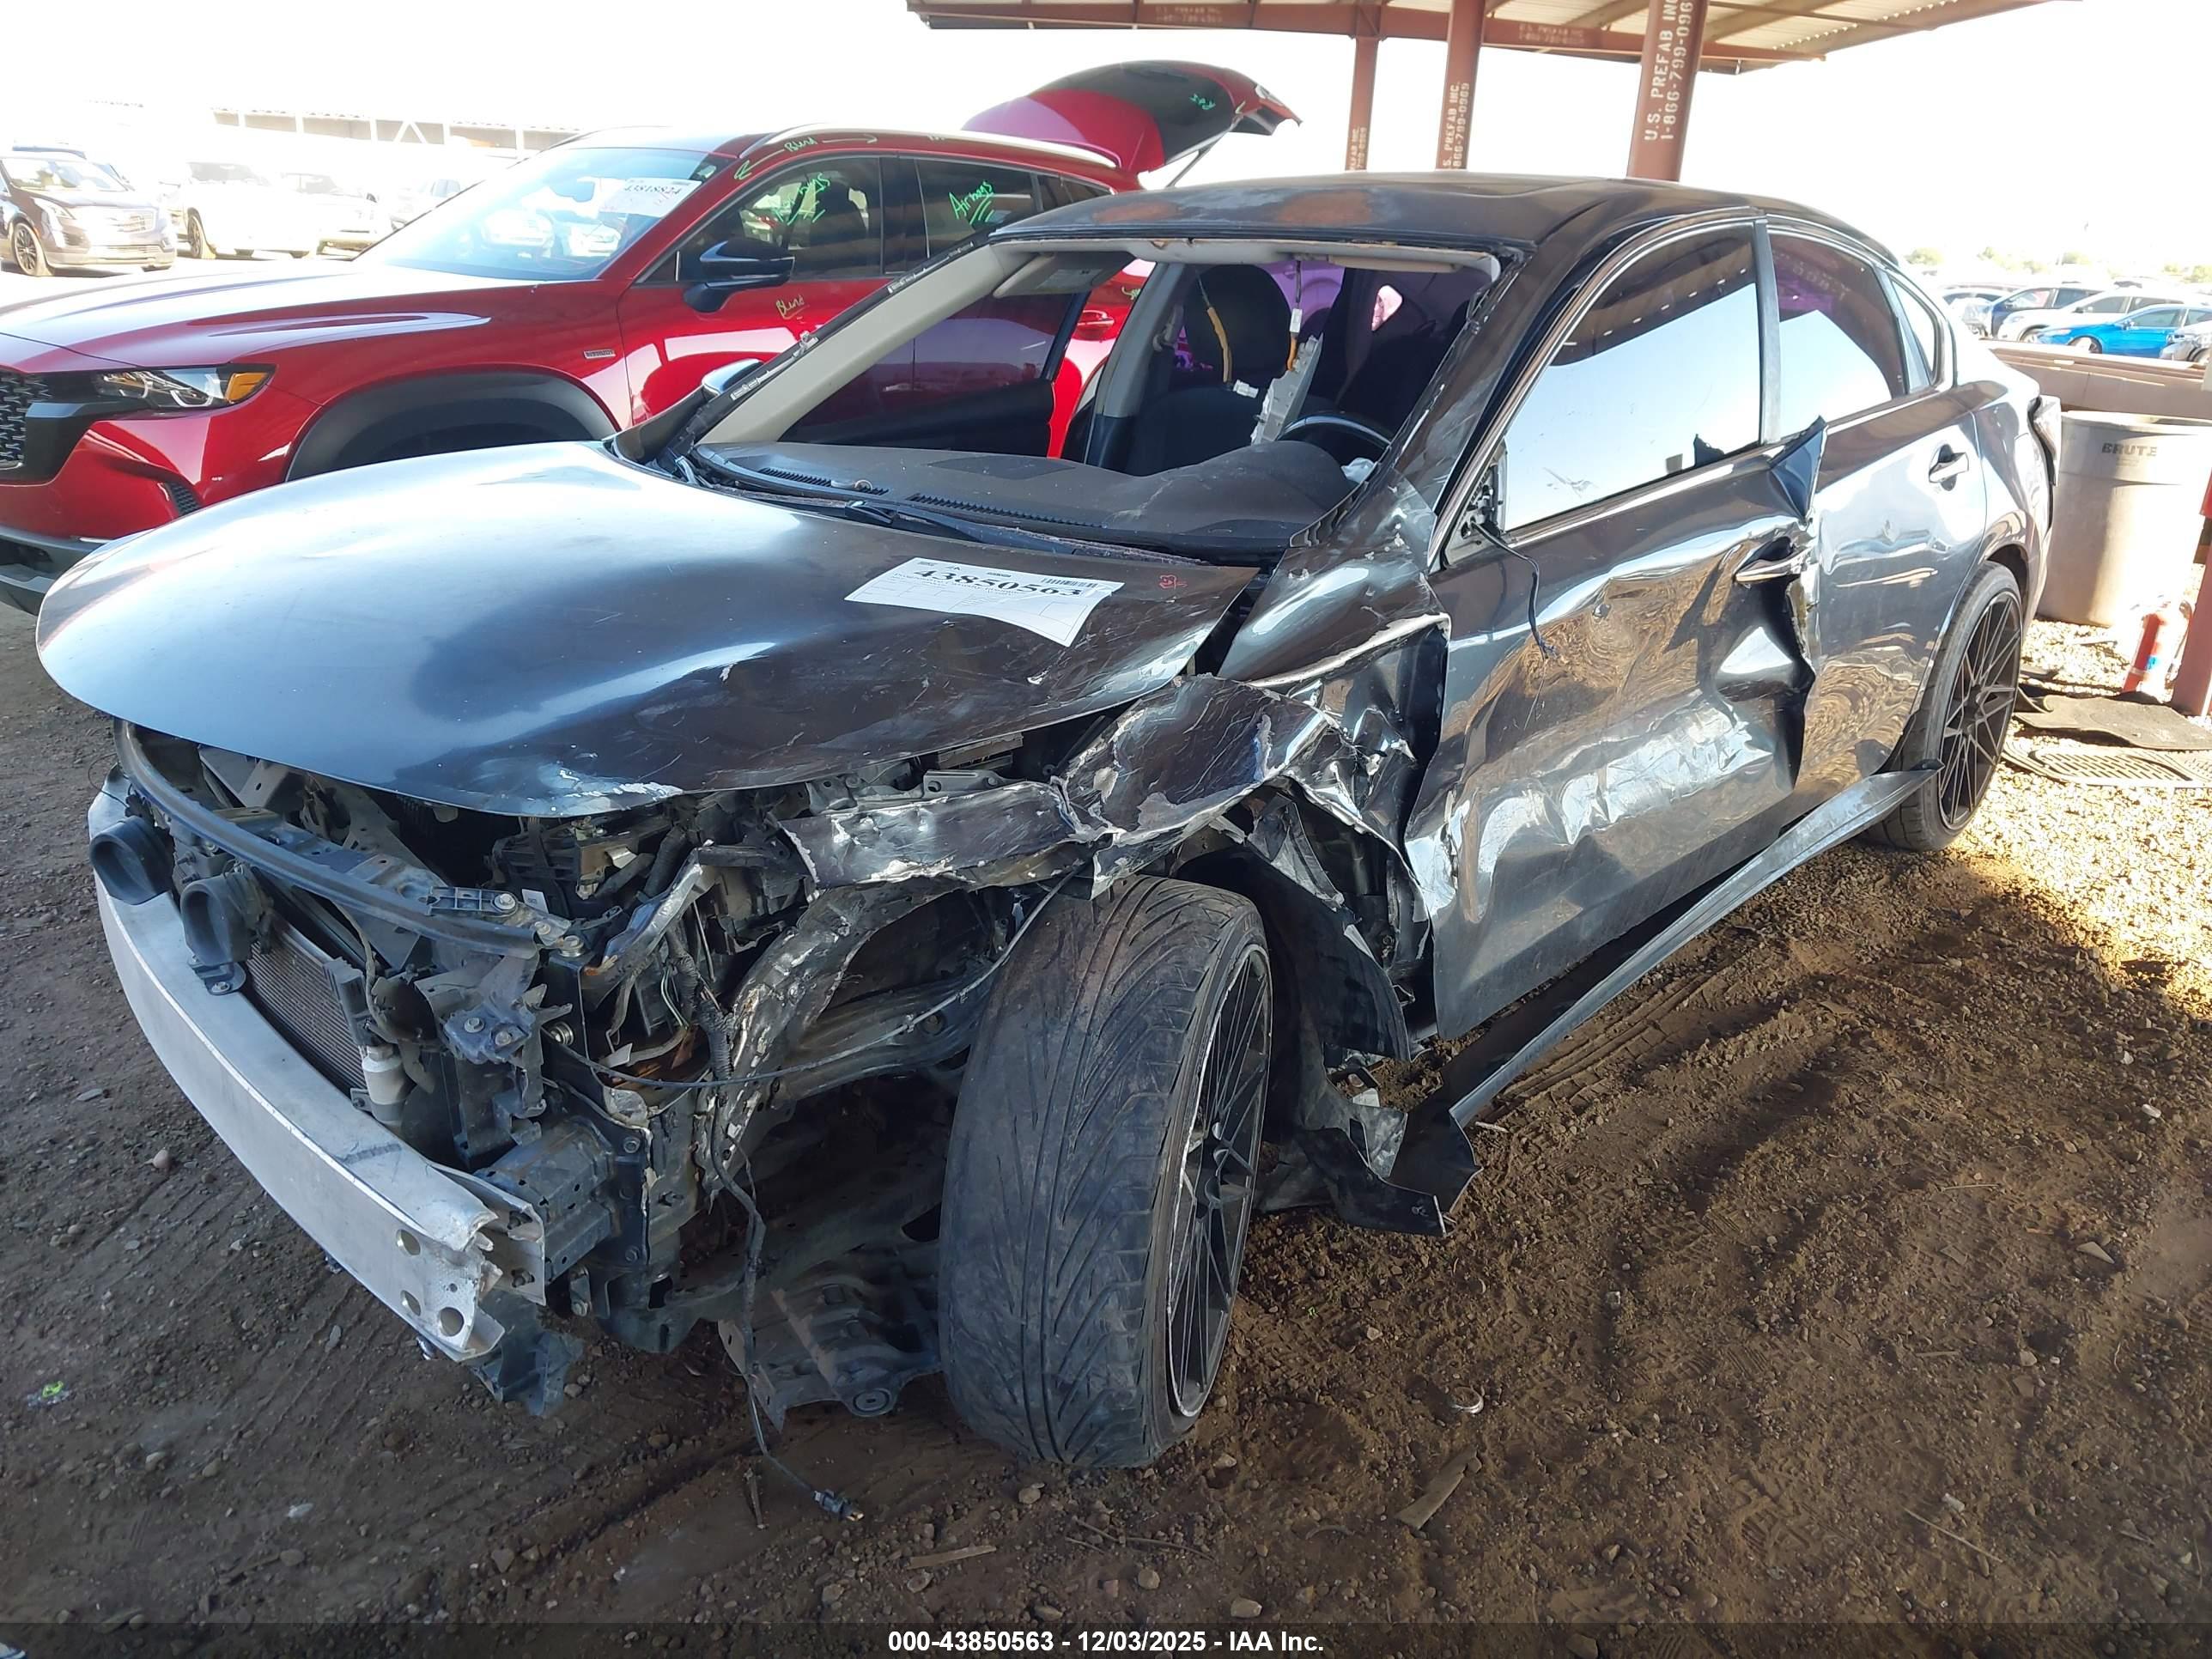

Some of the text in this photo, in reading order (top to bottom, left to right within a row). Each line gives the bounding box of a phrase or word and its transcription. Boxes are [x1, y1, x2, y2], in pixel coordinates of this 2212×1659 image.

[1650, 29, 1674, 99] PREFAB
[1443, 107, 1458, 151] PREFAB
[1644, 108, 1662, 141] U.S.
[2102, 442, 2157, 457] BRUTE
[913, 570, 1083, 597] 43850563
